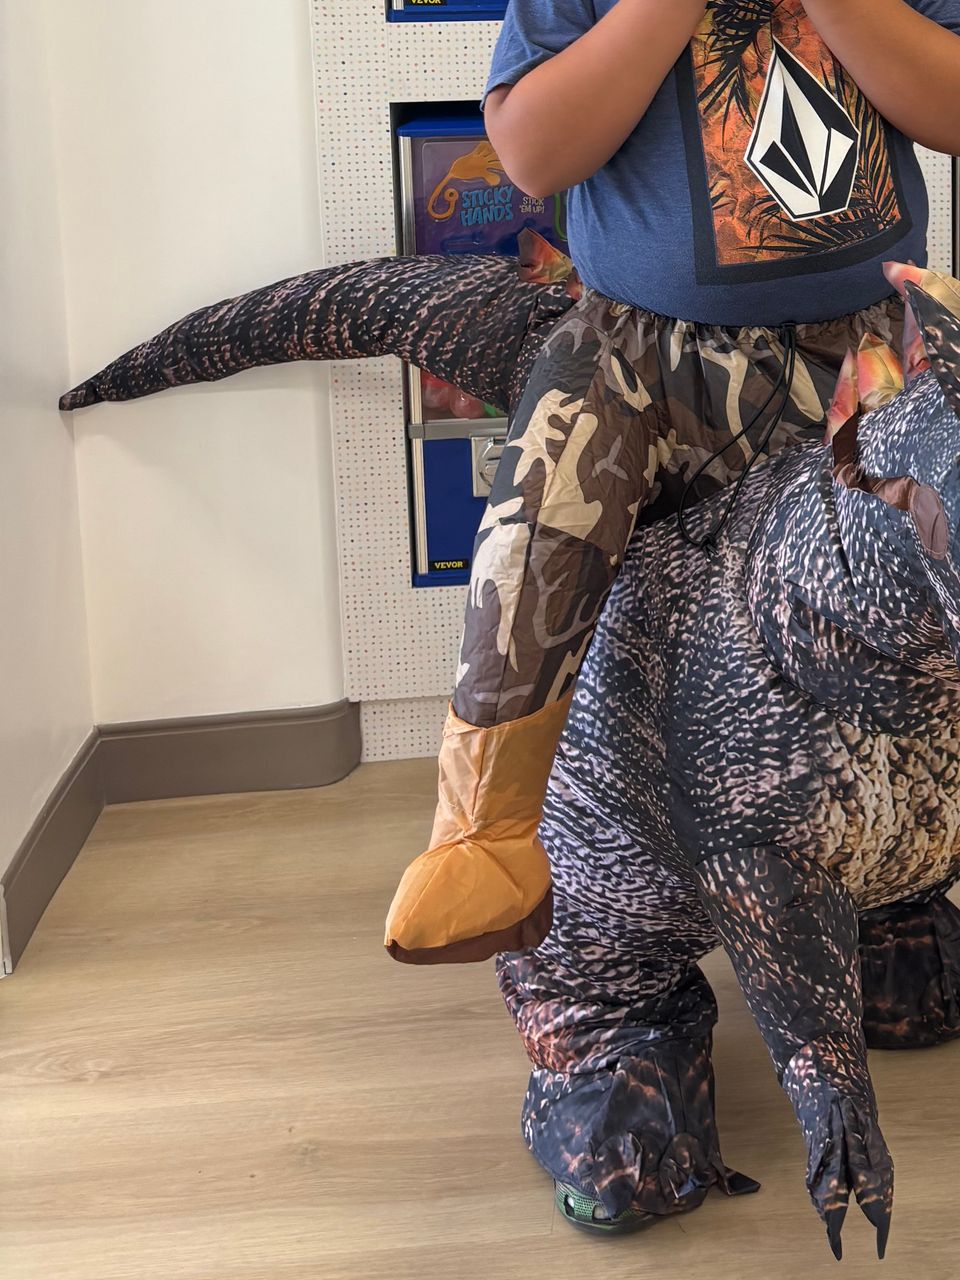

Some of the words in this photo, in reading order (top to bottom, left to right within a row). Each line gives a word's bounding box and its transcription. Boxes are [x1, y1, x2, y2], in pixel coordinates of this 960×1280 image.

[461, 185, 514, 209] STICKY
[522, 196, 545, 206] STICK
[460, 203, 514, 227] HANDS
[434, 561, 463, 569] VEVOR
